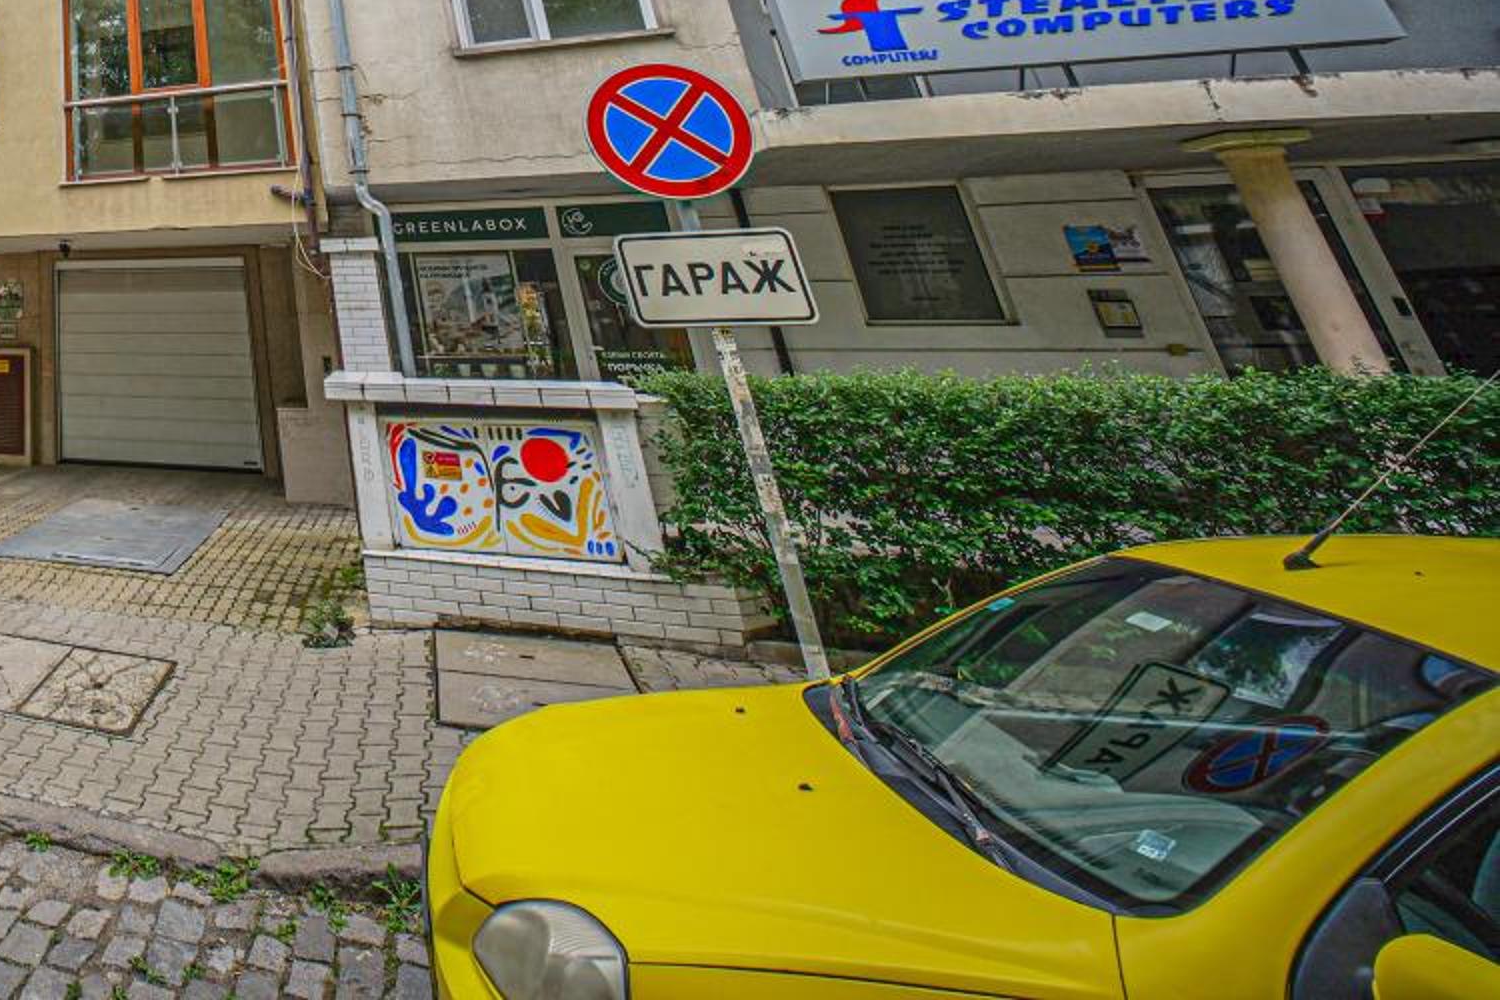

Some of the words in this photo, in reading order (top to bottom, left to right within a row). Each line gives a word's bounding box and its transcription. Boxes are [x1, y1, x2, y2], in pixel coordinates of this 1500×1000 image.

[841, 49, 938, 66] COMPUTERS
[394, 217, 527, 235] GREENLABOX
[633, 259, 796, 297] ГАРАЖ
